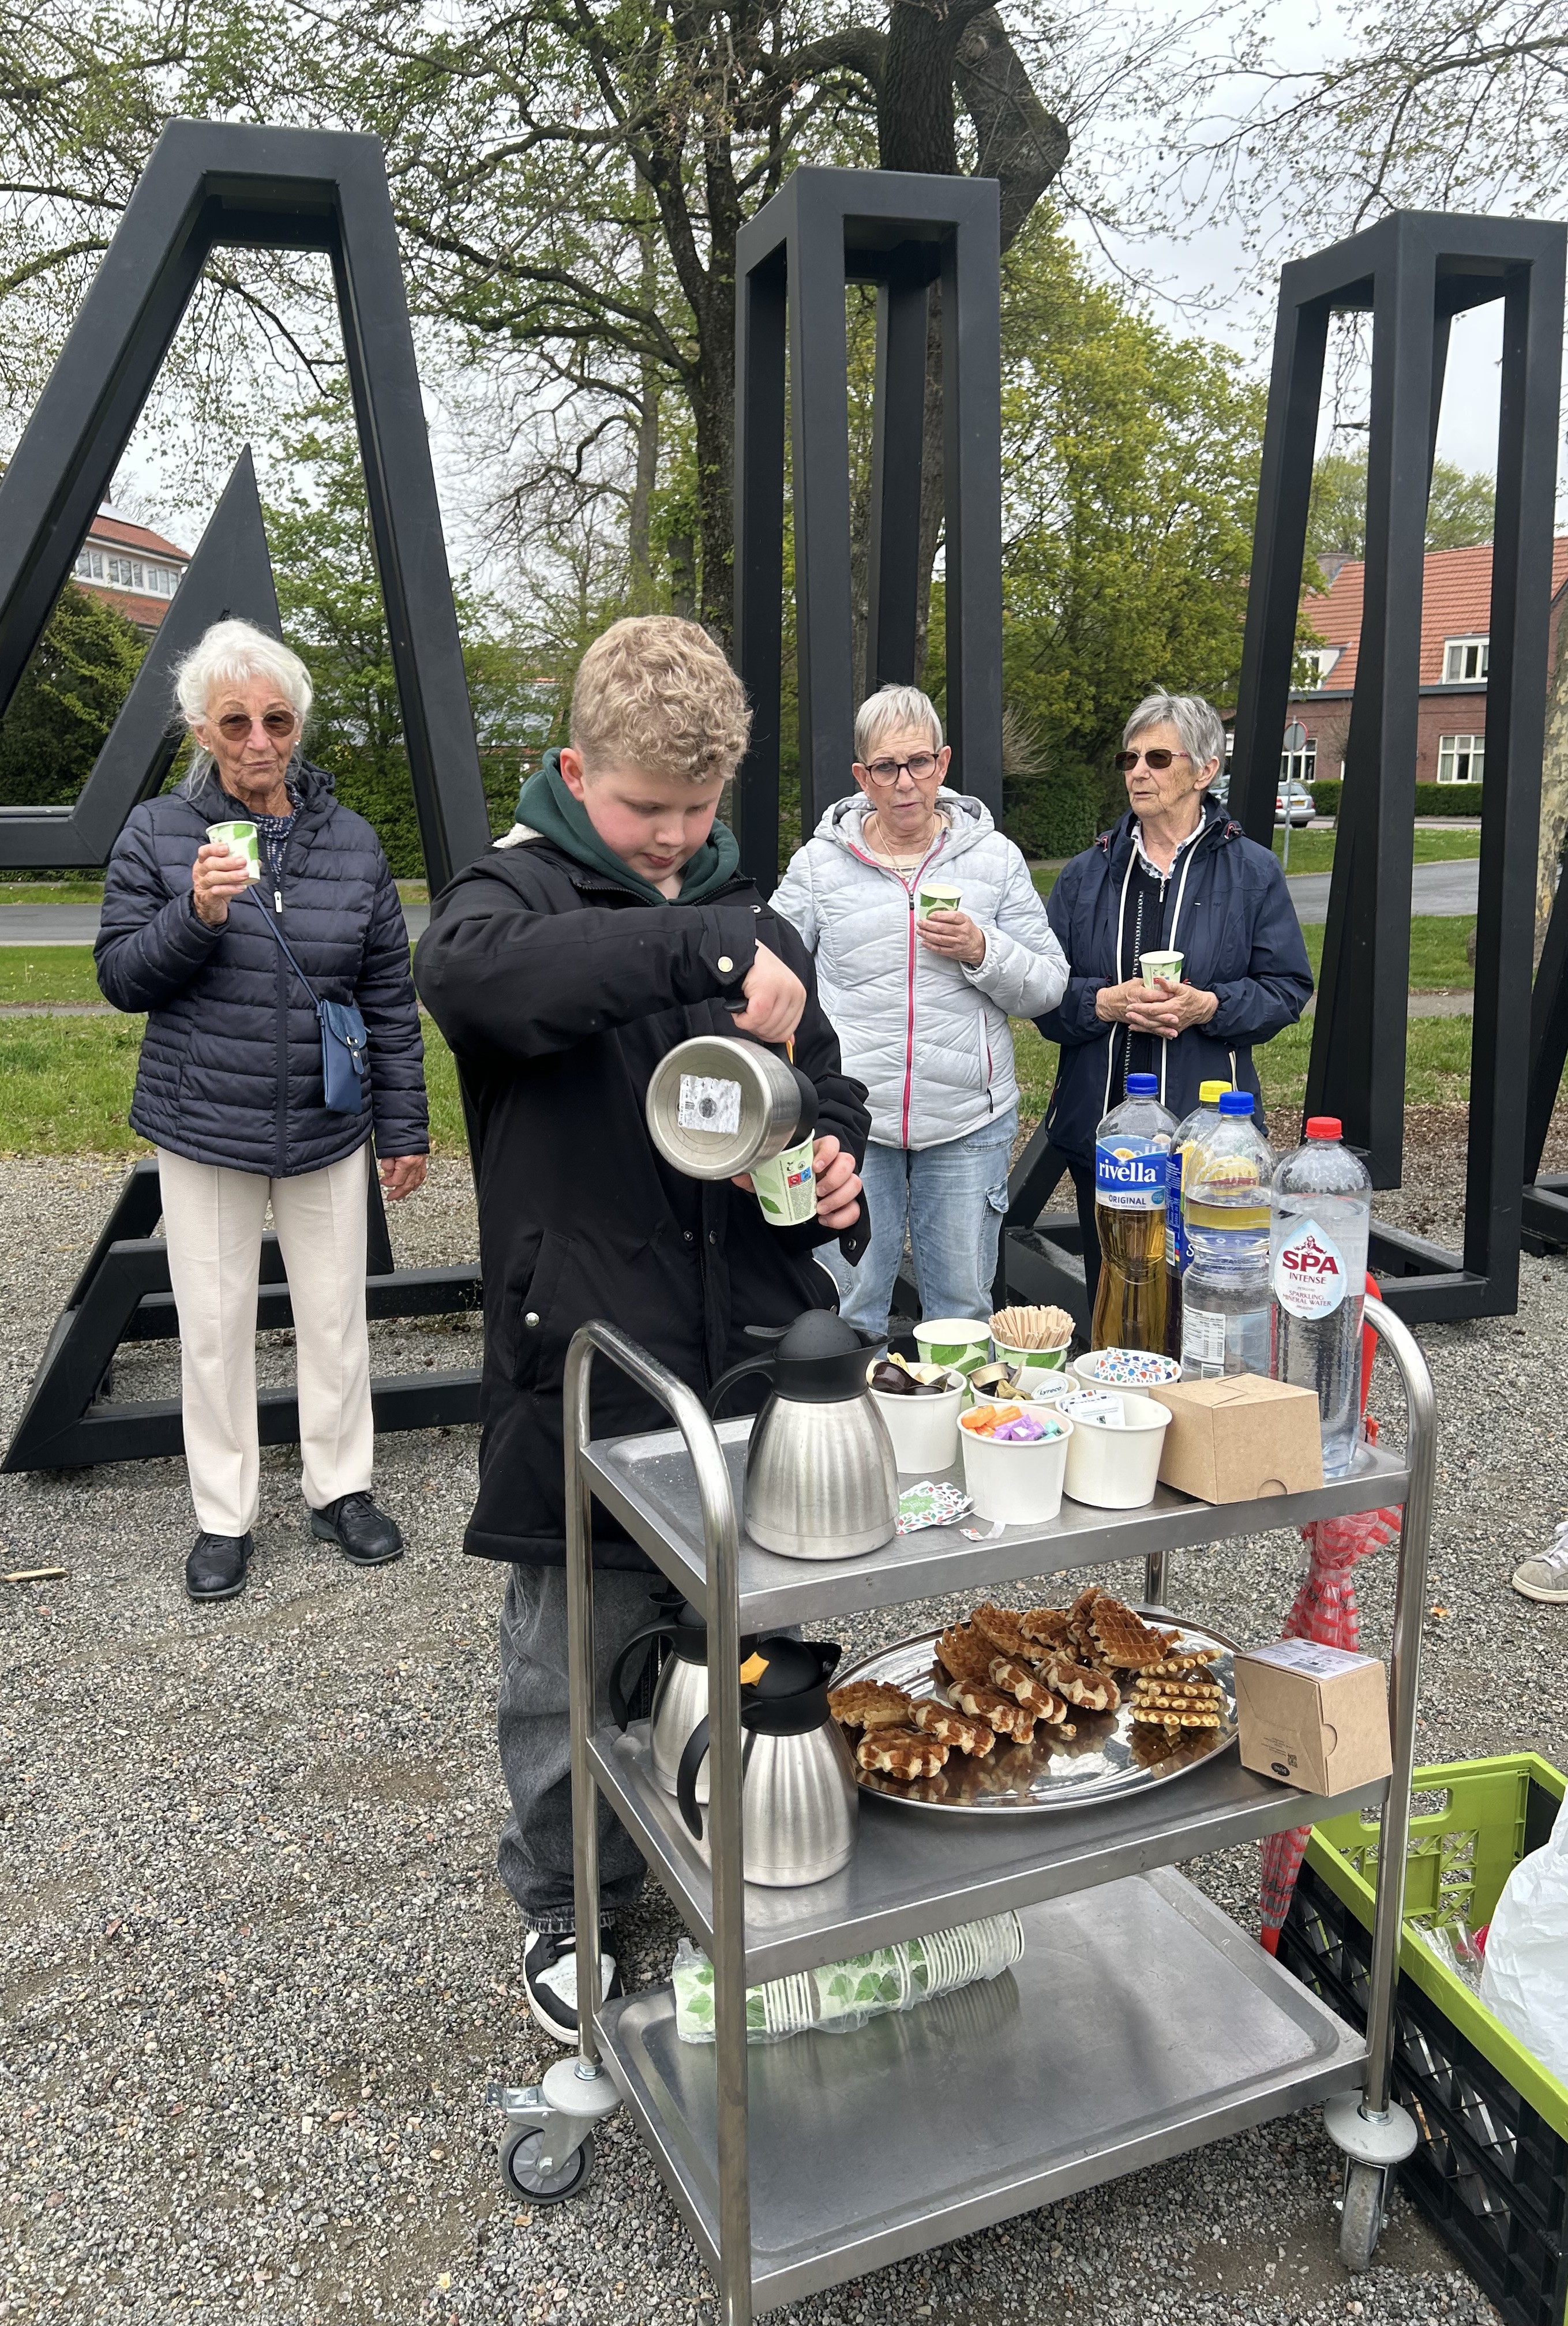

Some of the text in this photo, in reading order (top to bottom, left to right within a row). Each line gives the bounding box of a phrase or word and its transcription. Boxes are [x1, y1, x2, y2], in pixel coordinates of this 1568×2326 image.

[1099, 1158, 1157, 1183] rivella
[1108, 1194, 1147, 1205] ORIGINAL
[1282, 1250, 1340, 1275] SPA
[1289, 1272, 1327, 1284] INTENSE
[1282, 1293, 1308, 1304] MINERAL
[1289, 1290, 1324, 1301] SPARKLING
